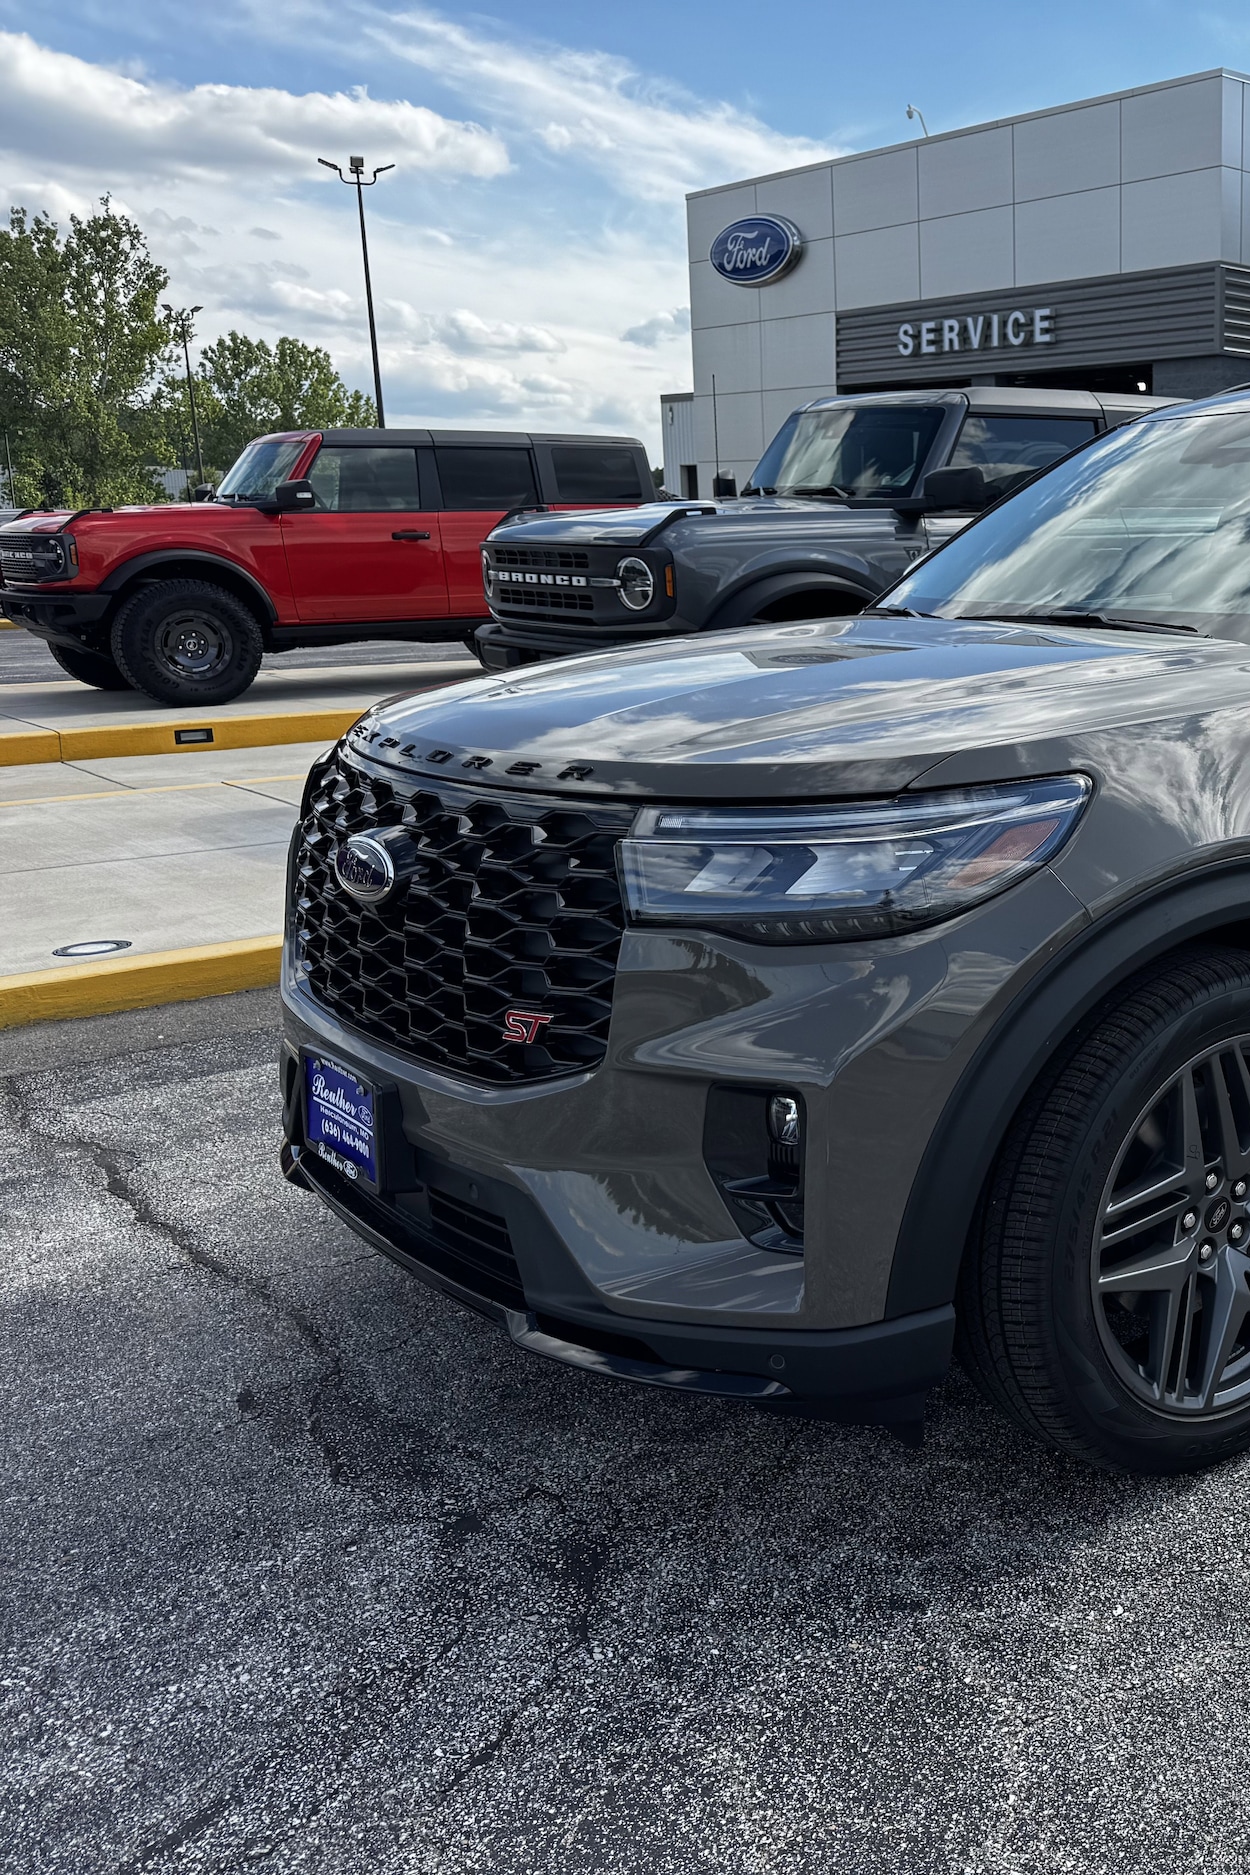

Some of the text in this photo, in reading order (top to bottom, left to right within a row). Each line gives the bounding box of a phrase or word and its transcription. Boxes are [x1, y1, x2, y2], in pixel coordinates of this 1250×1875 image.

[723, 231, 771, 271] Ford
[897, 308, 1055, 357] SERVICE
[498, 571, 587, 587] BRONCO
[352, 723, 596, 781] EXPLORER
[342, 848, 374, 888] Ford
[502, 1010, 555, 1044] ST
[312, 1074, 357, 1117] Reuther
[322, 1119, 340, 1142] (636)
[360, 1129, 369, 1141] MO
[318, 1142, 343, 1171] Reuther
